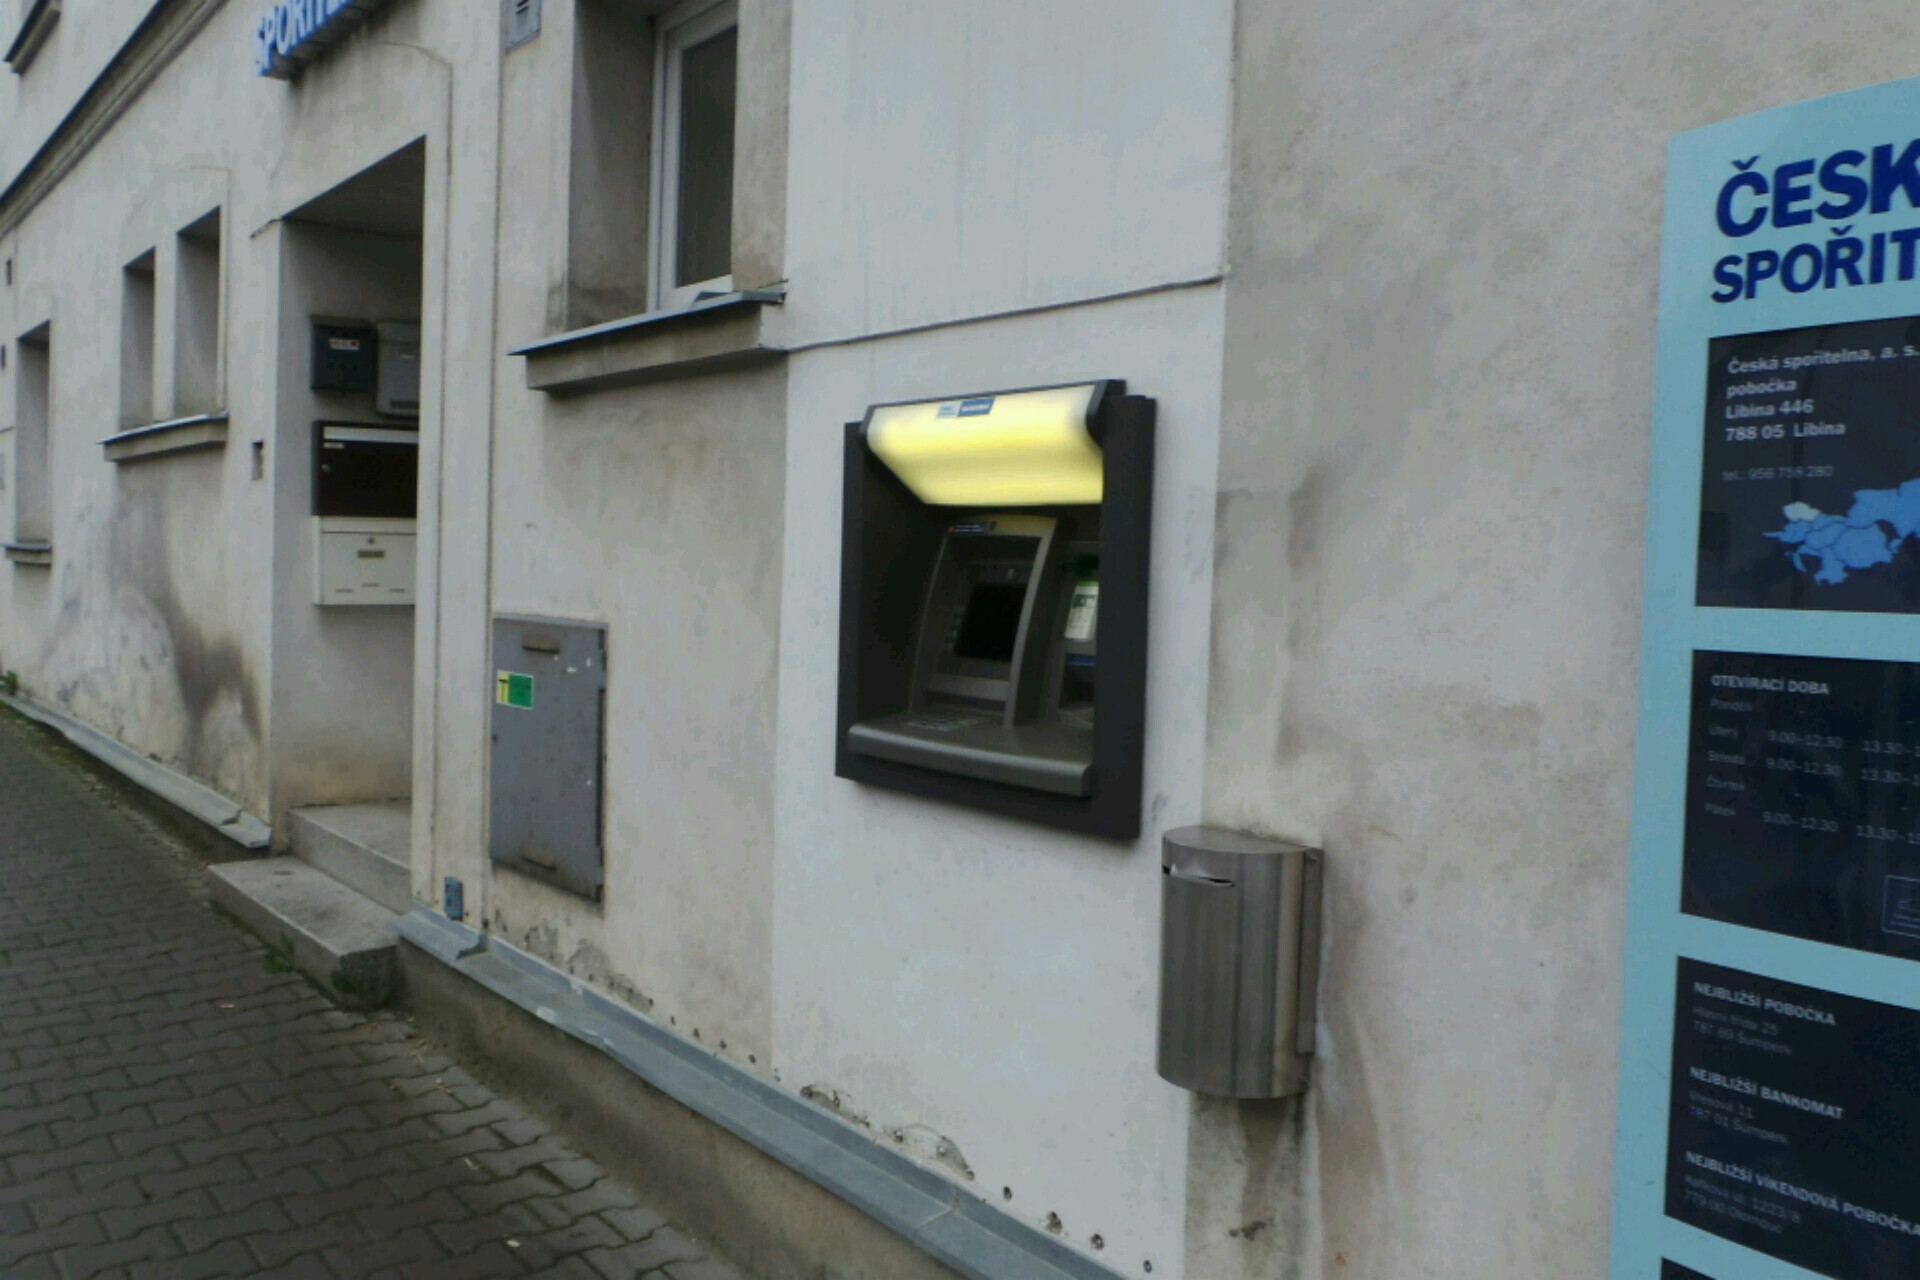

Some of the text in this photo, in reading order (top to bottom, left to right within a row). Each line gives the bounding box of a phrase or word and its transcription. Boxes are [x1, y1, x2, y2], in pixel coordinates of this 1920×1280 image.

[1727, 355, 1779, 374] Česká
[1726, 378, 1798, 399] pobočka
[1725, 398, 1815, 420] Libina 446
[1761, 424, 1785, 439] 05
[1793, 420, 1847, 437] Libina
[1788, 680, 1830, 695] DOBA
[1764, 998, 1837, 1026] POBOČKA
[1760, 1084, 1845, 1120] BANKOMAT
